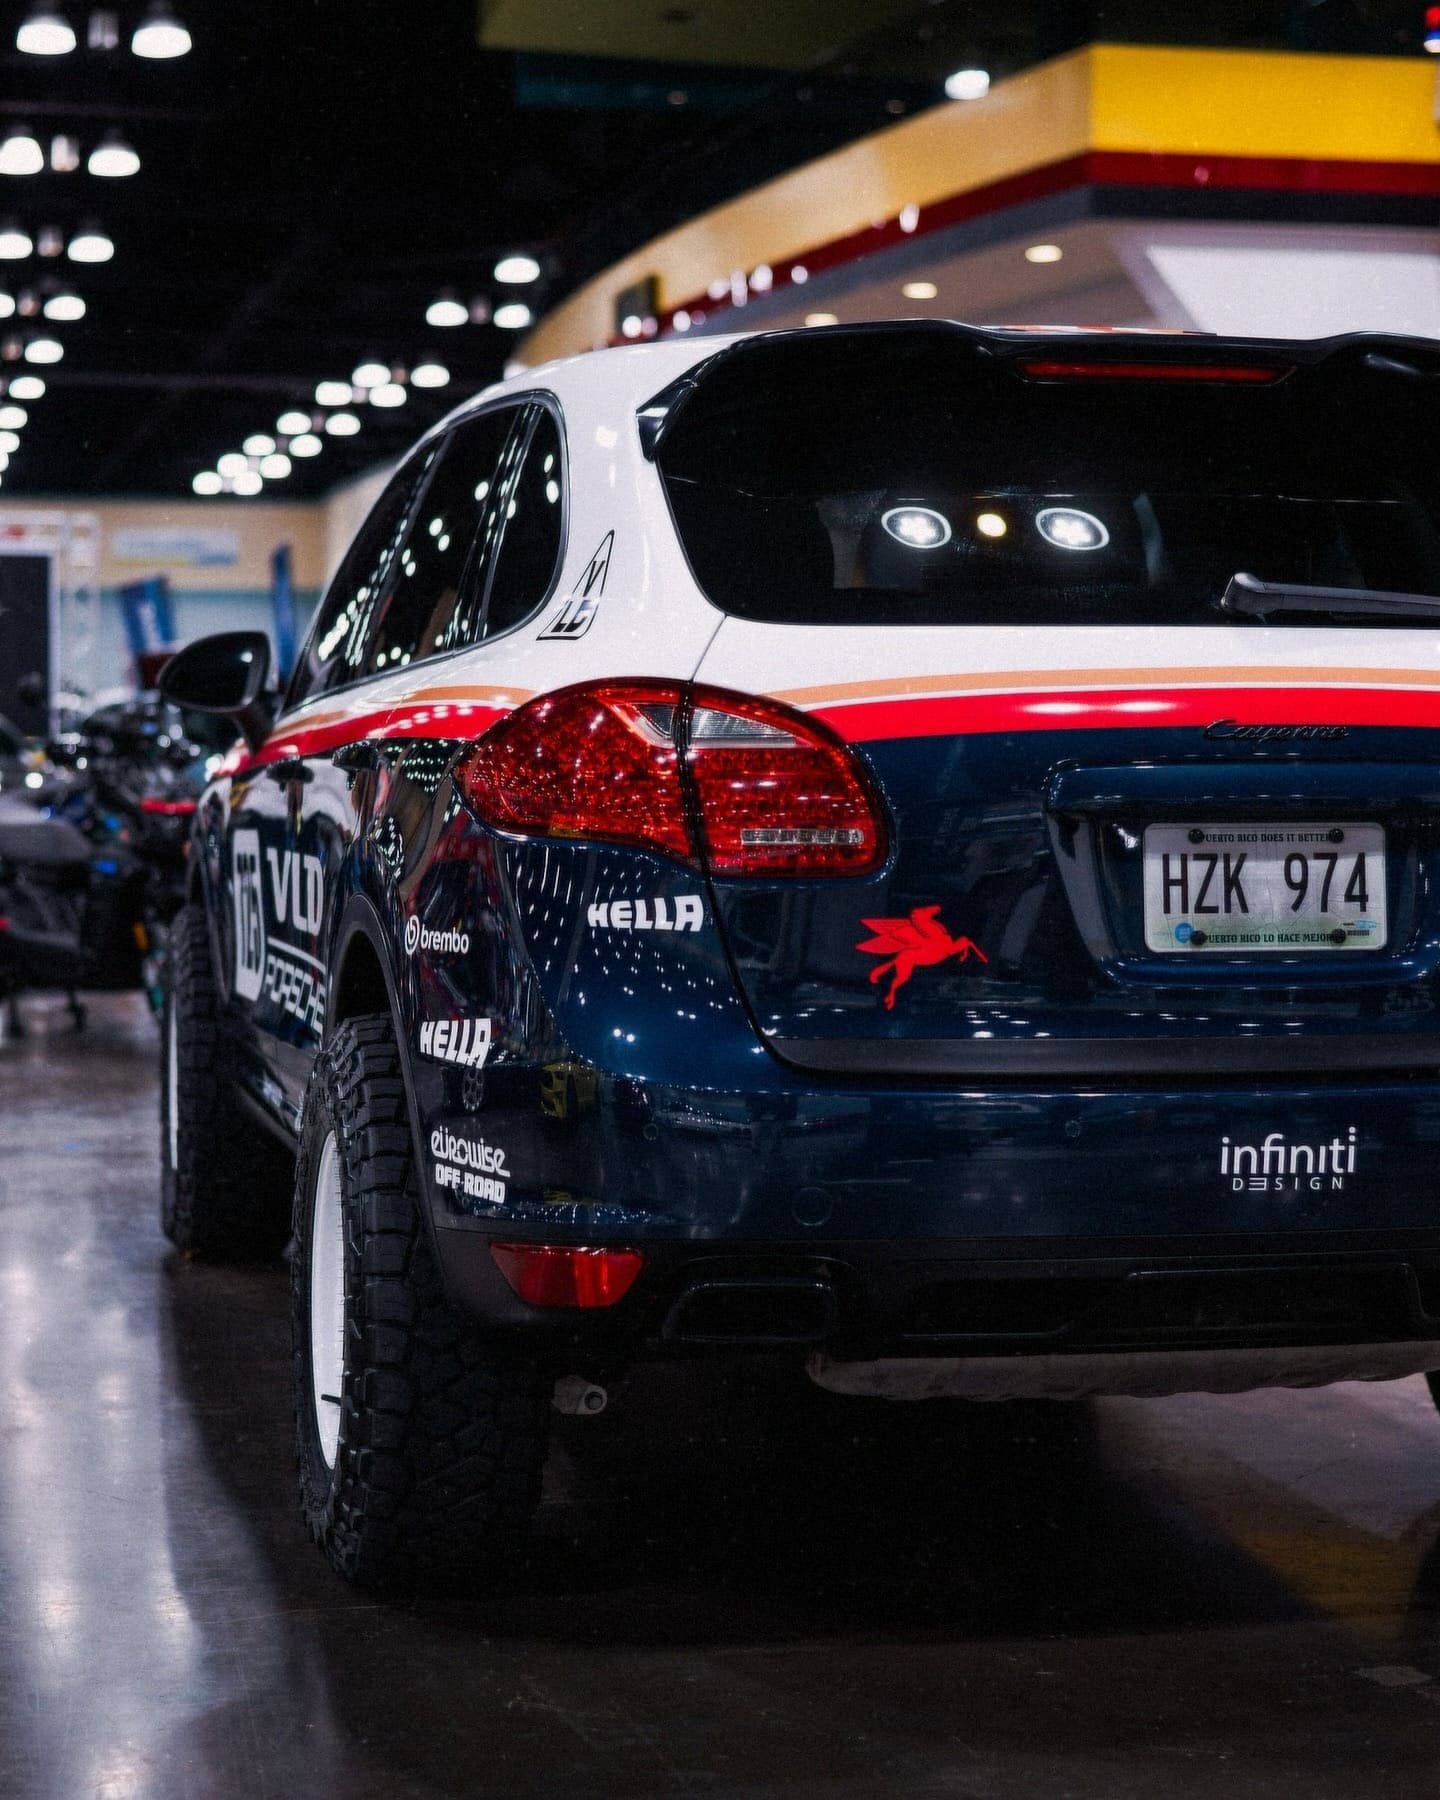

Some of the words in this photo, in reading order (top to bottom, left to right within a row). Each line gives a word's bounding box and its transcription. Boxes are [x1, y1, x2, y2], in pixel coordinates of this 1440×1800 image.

[1205, 833, 1234, 843] UERTO
[1238, 833, 1258, 843] RICO
[1261, 833, 1284, 843] DOES
[1286, 833, 1295, 843] IT
[267, 847, 323, 937] VLD
[1162, 853, 1249, 914] HZK
[1284, 852, 1369, 913] 974
[587, 894, 704, 932] HELLA
[420, 922, 470, 955] brembo
[1240, 933, 1260, 944] RICO
[1263, 933, 1275, 944] LO
[1277, 933, 1301, 944] HACE
[420, 1018, 492, 1069] HELLA
[1220, 1126, 1356, 1175] infiniti
